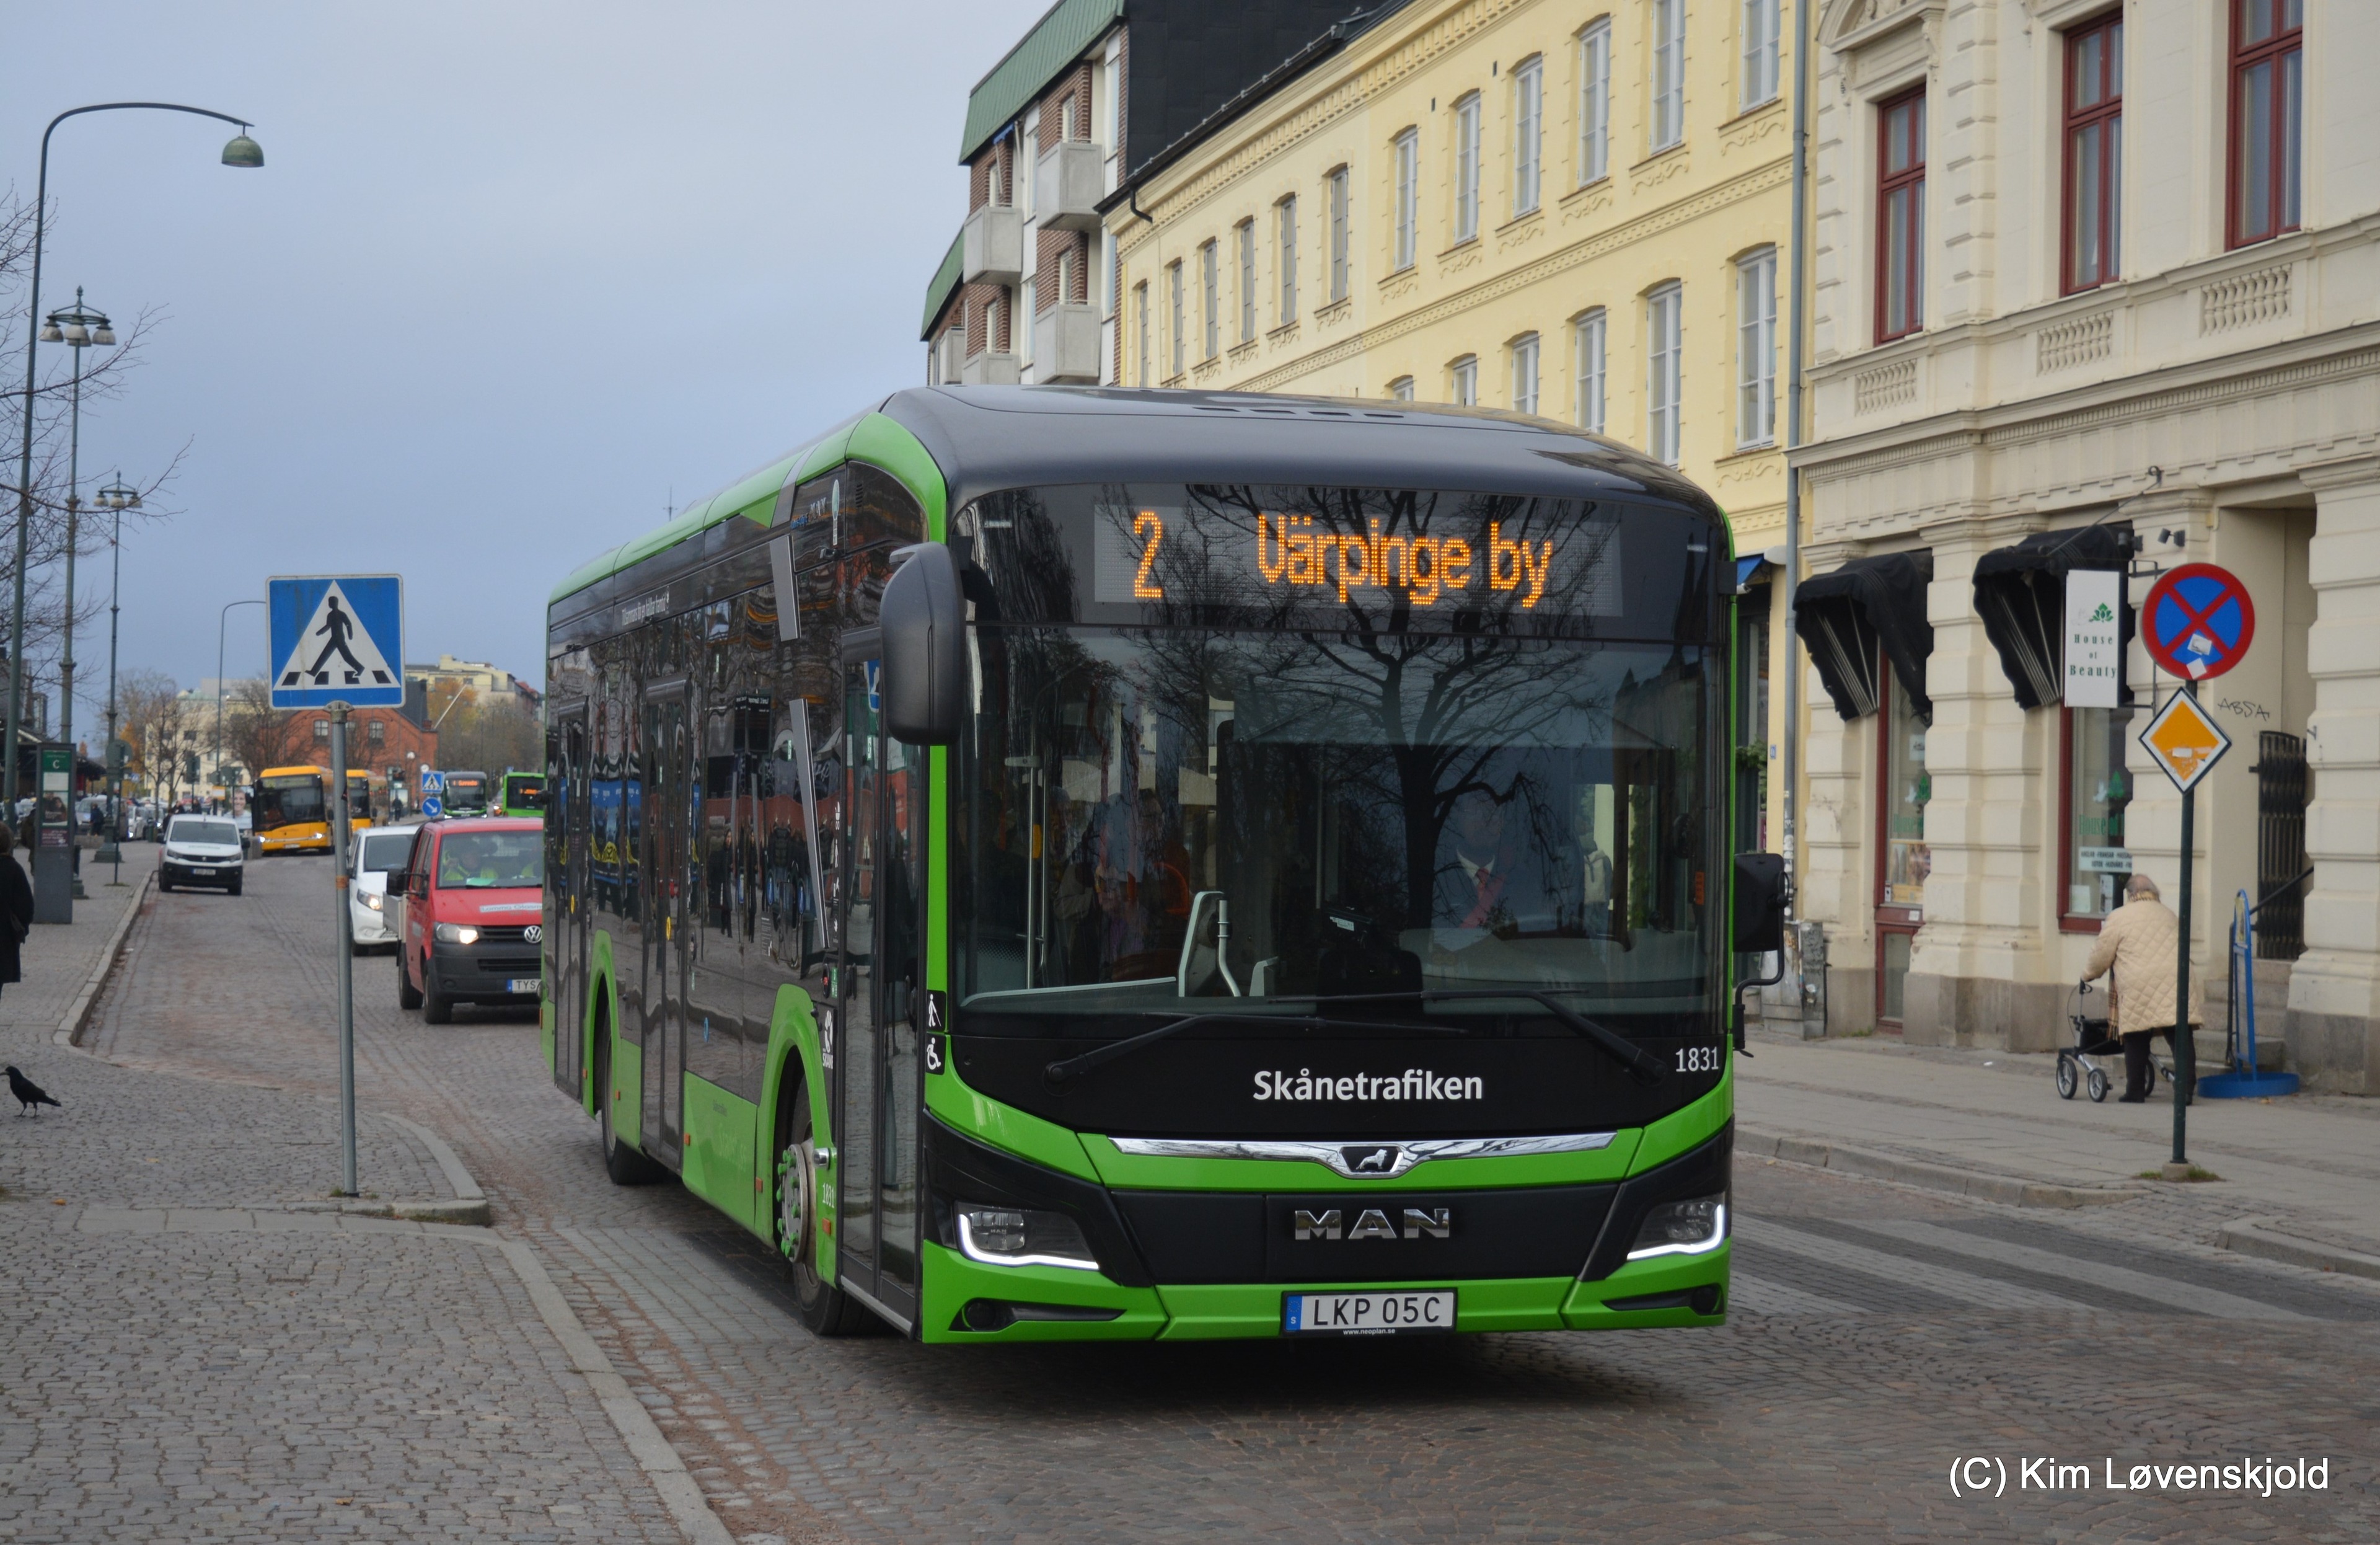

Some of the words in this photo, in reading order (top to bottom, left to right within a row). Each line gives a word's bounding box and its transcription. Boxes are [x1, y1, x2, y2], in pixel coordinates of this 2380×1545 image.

[1133, 511, 1163, 598] 2
[1257, 514, 1472, 606] Värpinge
[1490, 521, 1552, 608] by
[2074, 634, 2113, 645] House
[2069, 664, 2116, 679] Beauty
[52, 759, 60, 769] C
[516, 980, 536, 989] TYS
[1675, 1046, 1719, 1073] 1831
[1252, 1068, 1483, 1100] Skånetrafiken
[822, 1182, 835, 1209] 1831
[1295, 1208, 1450, 1241] MAN
[1290, 1316, 1297, 1324] S
[1313, 1298, 1371, 1326] LKP
[1382, 1296, 1440, 1324] 05C
[1342, 1327, 1396, 1335] www.neoplan.se
